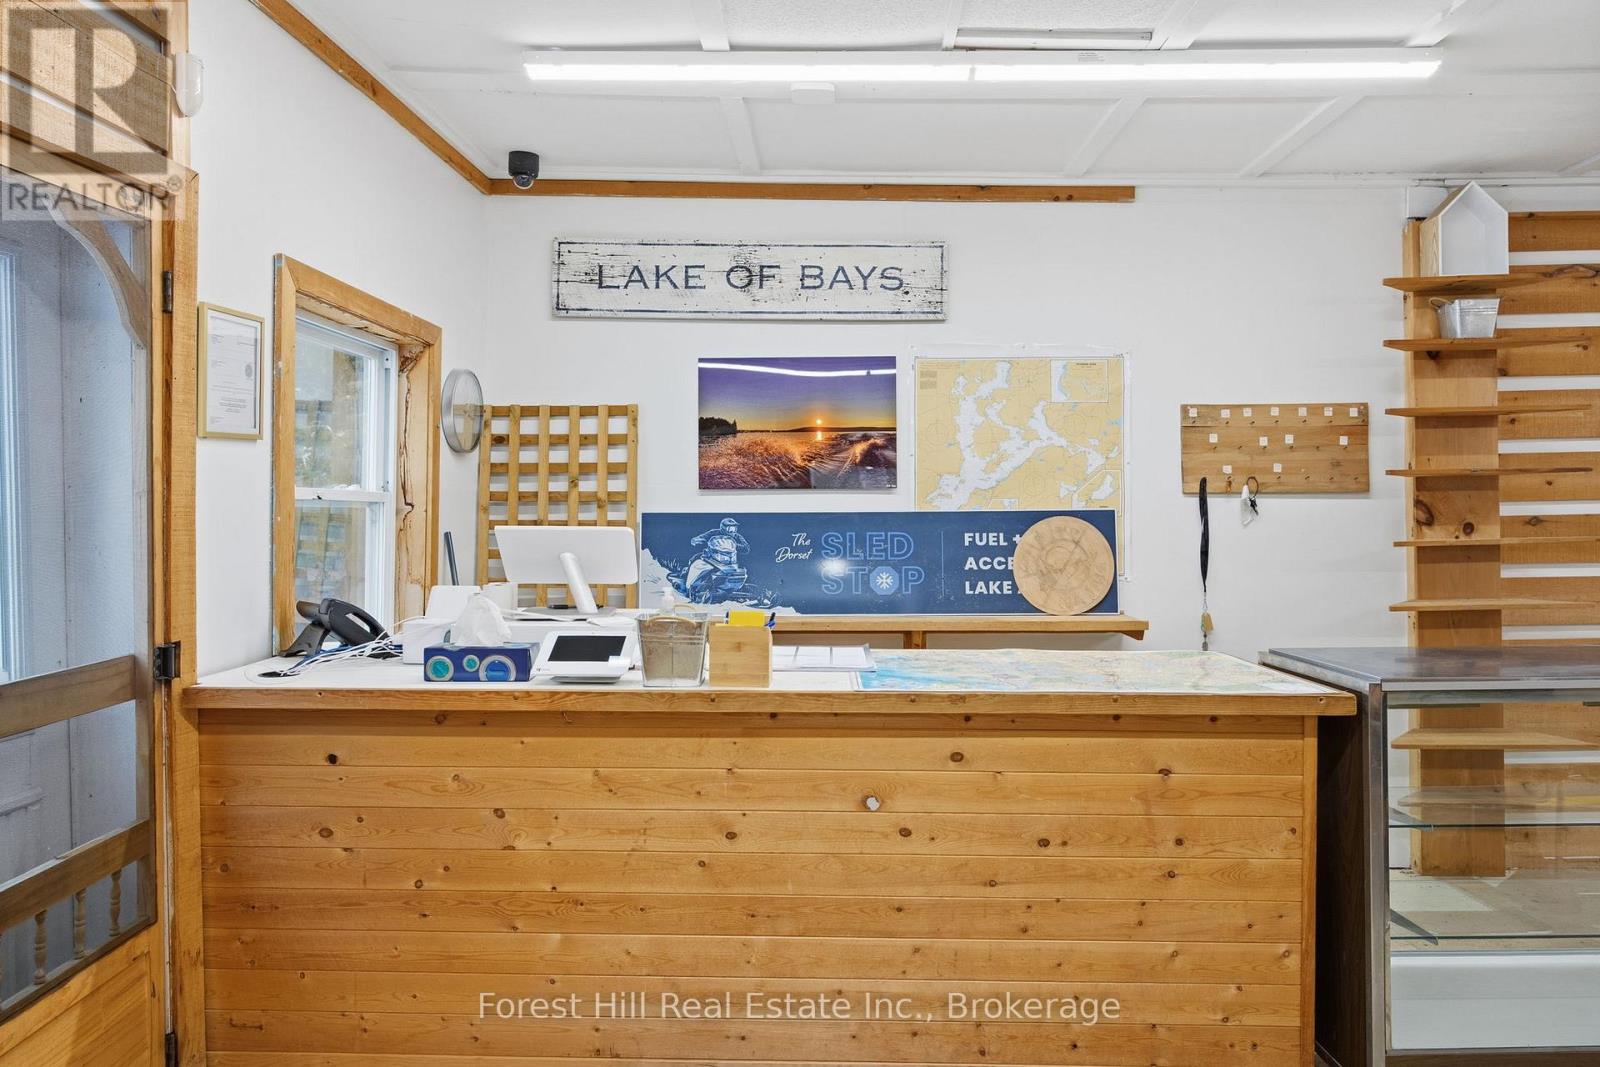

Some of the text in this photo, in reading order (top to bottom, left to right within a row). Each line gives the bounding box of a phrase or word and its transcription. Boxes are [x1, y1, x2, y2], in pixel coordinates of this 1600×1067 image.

[597, 264, 904, 292] LAKE OF BAYS
[792, 532, 811, 547] The
[821, 532, 914, 560] SLED
[964, 532, 1008, 546] FUEL
[775, 546, 813, 563] Dorset
[821, 565, 925, 595] STOP
[965, 581, 1012, 595] LAKE
